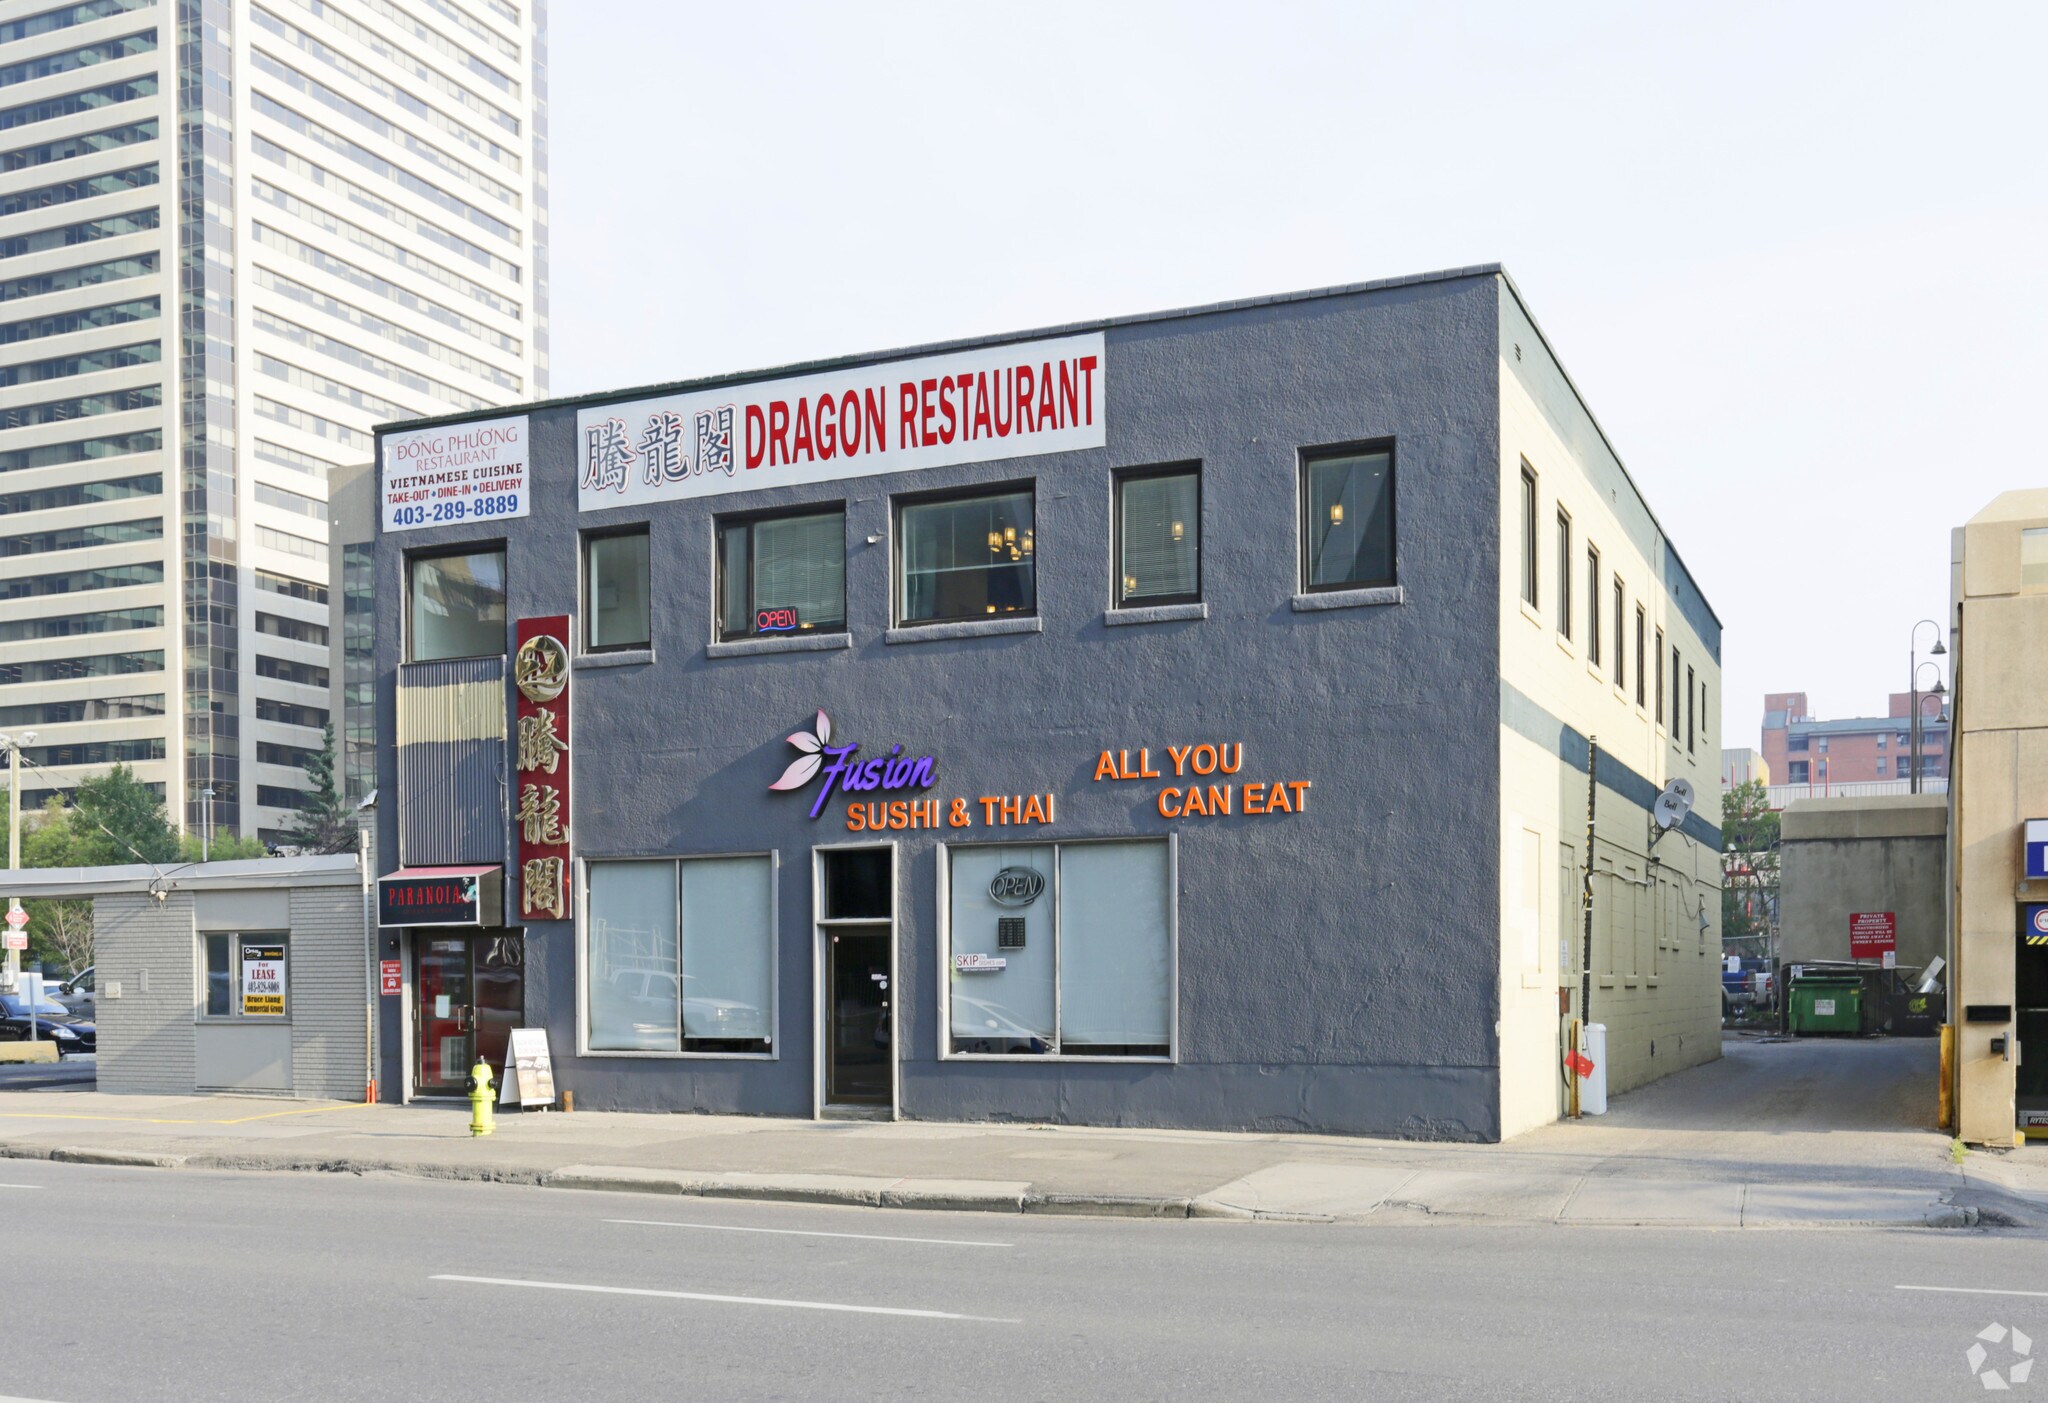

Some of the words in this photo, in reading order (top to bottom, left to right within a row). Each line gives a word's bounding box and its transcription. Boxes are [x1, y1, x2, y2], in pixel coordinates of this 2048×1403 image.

[745, 385, 886, 470] DRAGON
[900, 355, 1098, 450] RESTAURANT
[448, 427, 518, 451] PHƯƠNG
[581, 404, 737, 494] 騰龍閣
[416, 447, 498, 471] RESTAURANT
[390, 470, 468, 489] VIETNAMESE
[473, 463, 523, 479] CUISINE
[388, 489, 430, 504] TAKE-OUT
[438, 484, 471, 498] DINE-IN
[479, 478, 522, 493] DELIVERY
[393, 494, 518, 525] 403-289-8889
[757, 609, 796, 628] OPEN
[1094, 747, 1160, 781] ALL
[1167, 743, 1242, 776] YOU
[809, 742, 937, 819] Fusion
[1674, 785, 1687, 796] Bell
[846, 799, 940, 831] SUSHI
[949, 797, 971, 827] &
[979, 794, 1054, 826] THAI
[1158, 784, 1231, 818] CAN
[1243, 781, 1312, 814] EAT
[1663, 800, 1677, 811] Bell
[515, 707, 570, 919] 騰龍閣
[389, 885, 460, 906] PARANOIA
[992, 875, 1037, 896] OPEN
[956, 955, 979, 967] SKIP
[252, 969, 276, 980] LEASE
